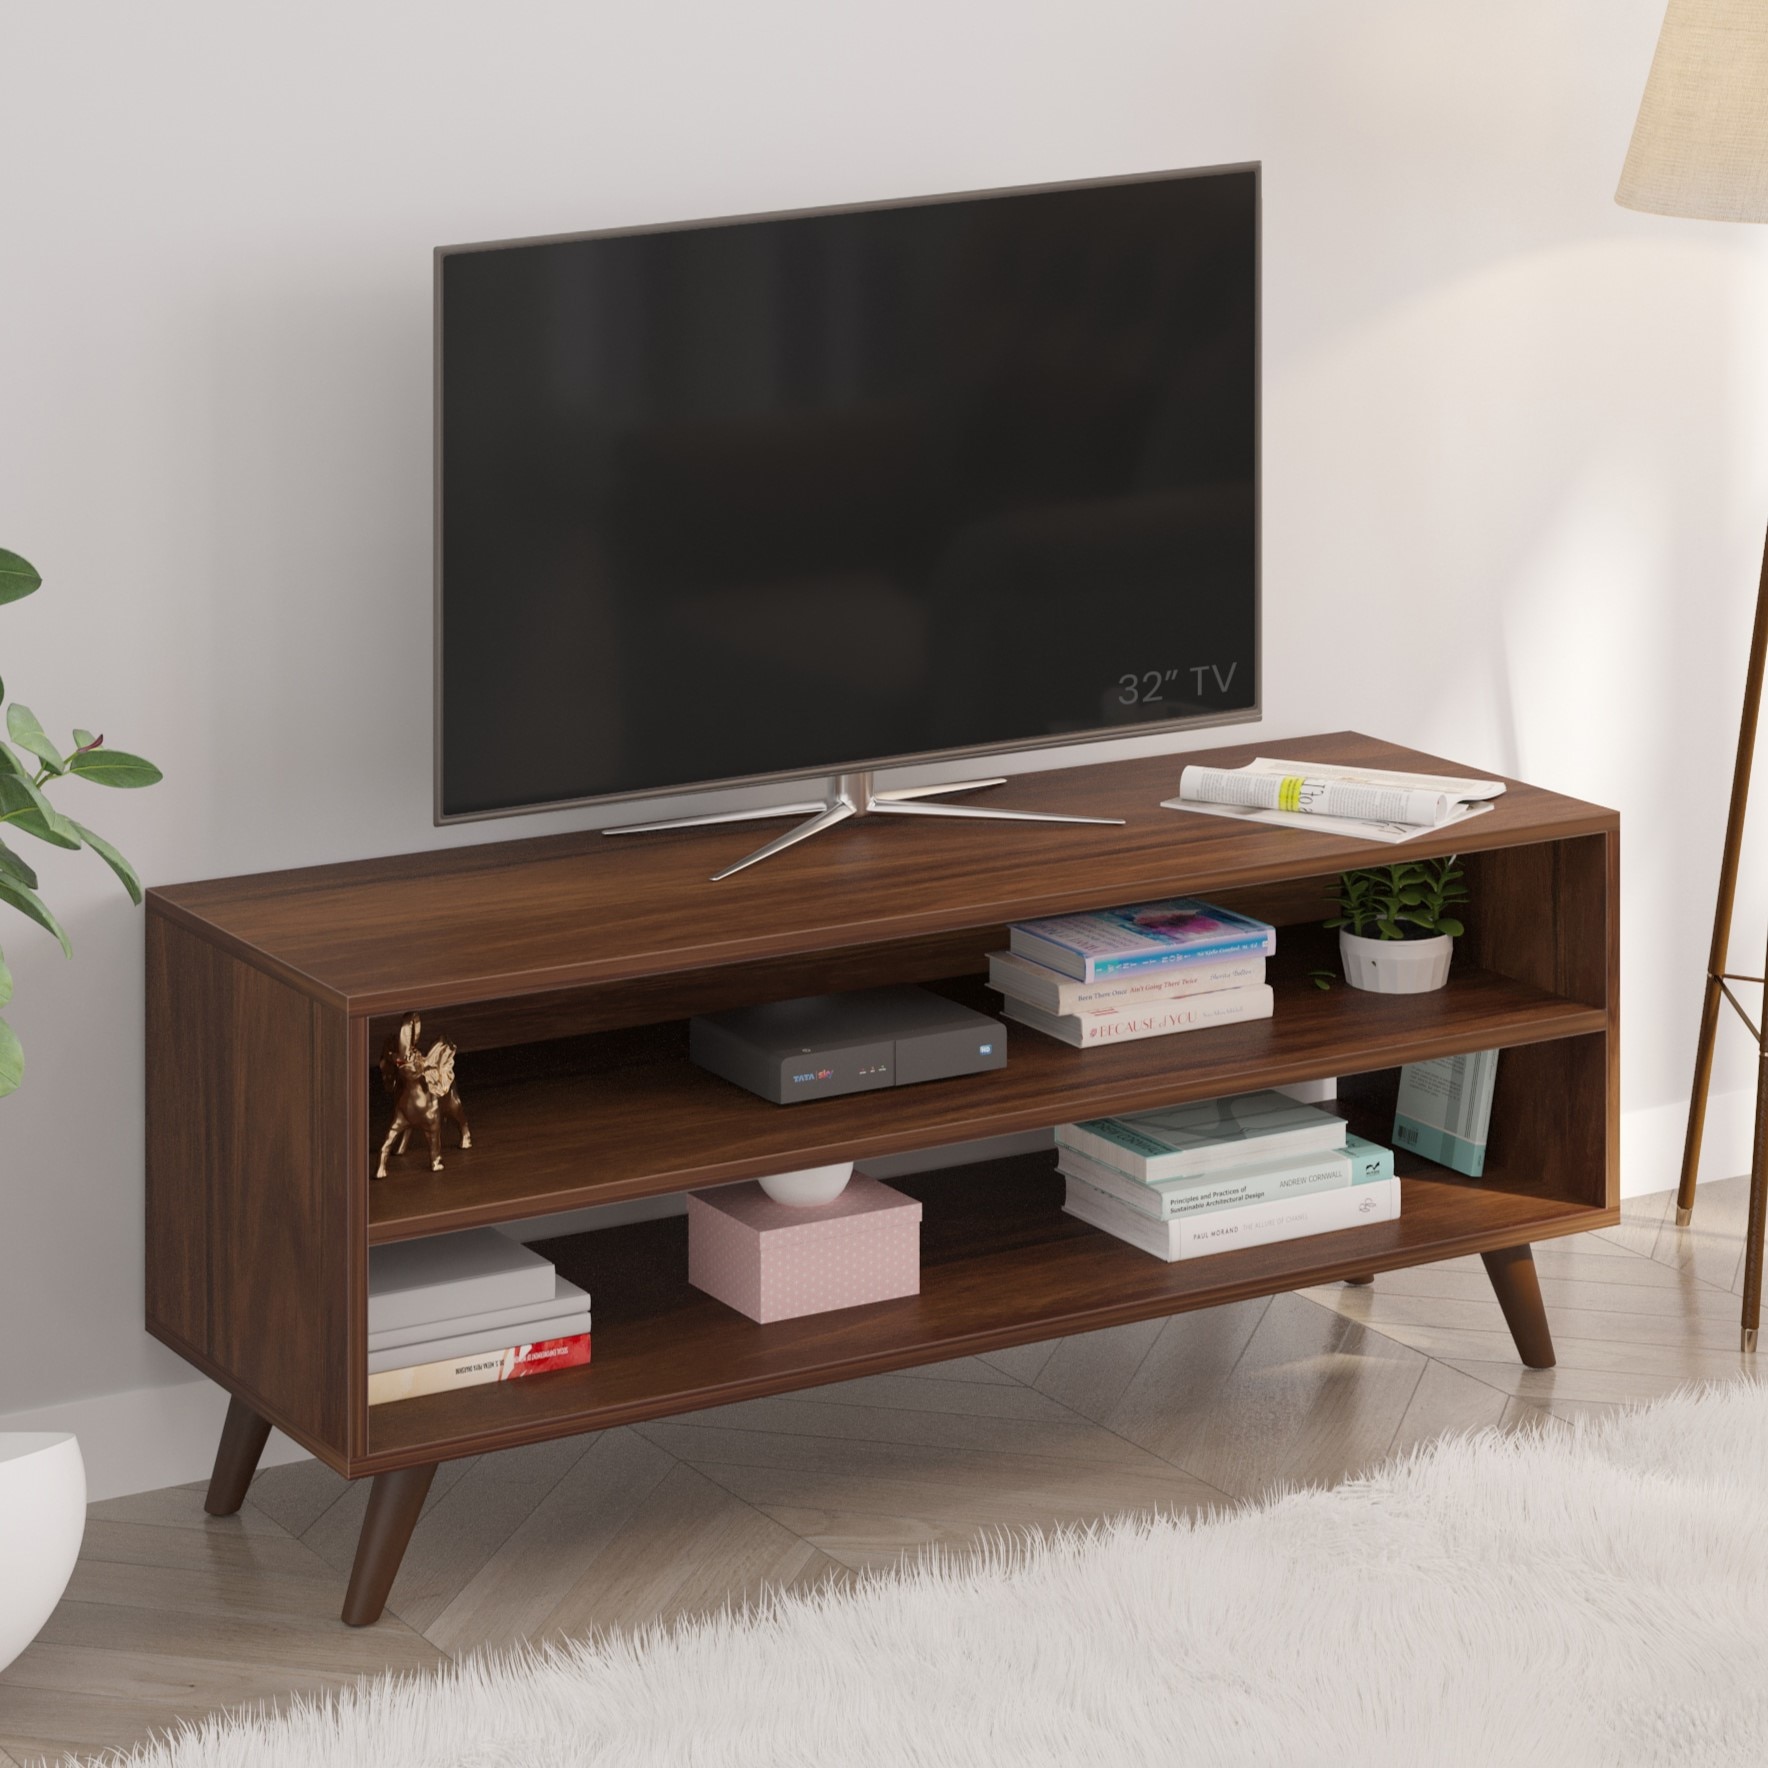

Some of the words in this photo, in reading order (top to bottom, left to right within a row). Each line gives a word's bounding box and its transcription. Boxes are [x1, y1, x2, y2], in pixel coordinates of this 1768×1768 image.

[1189, 661, 1238, 697] TV
[1078, 993, 1093, 1002] Been
[1094, 990, 1110, 1000] There
[1112, 988, 1128, 997] Once
[1145, 982, 1163, 993] Going
[1164, 980, 1180, 989] There
[1182, 977, 1198, 986] Twice
[1168, 1010, 1199, 1027] YOU
[792, 1072, 815, 1083] TATA
[818, 1069, 834, 1081] sky
[1279, 1177, 1307, 1189] ANDREW
[1308, 1170, 1343, 1183] CORNWALL
[1170, 1195, 1199, 1206] Principles
[1200, 1192, 1212, 1200] and
[1213, 1187, 1239, 1198] Practices
[1170, 1202, 1204, 1214] Sustainable
[1206, 1194, 1244, 1207] Architectural
[1245, 1191, 1265, 1200] Design
[1193, 1233, 1209, 1241] PAUL
[1211, 1226, 1239, 1237] MORAND
